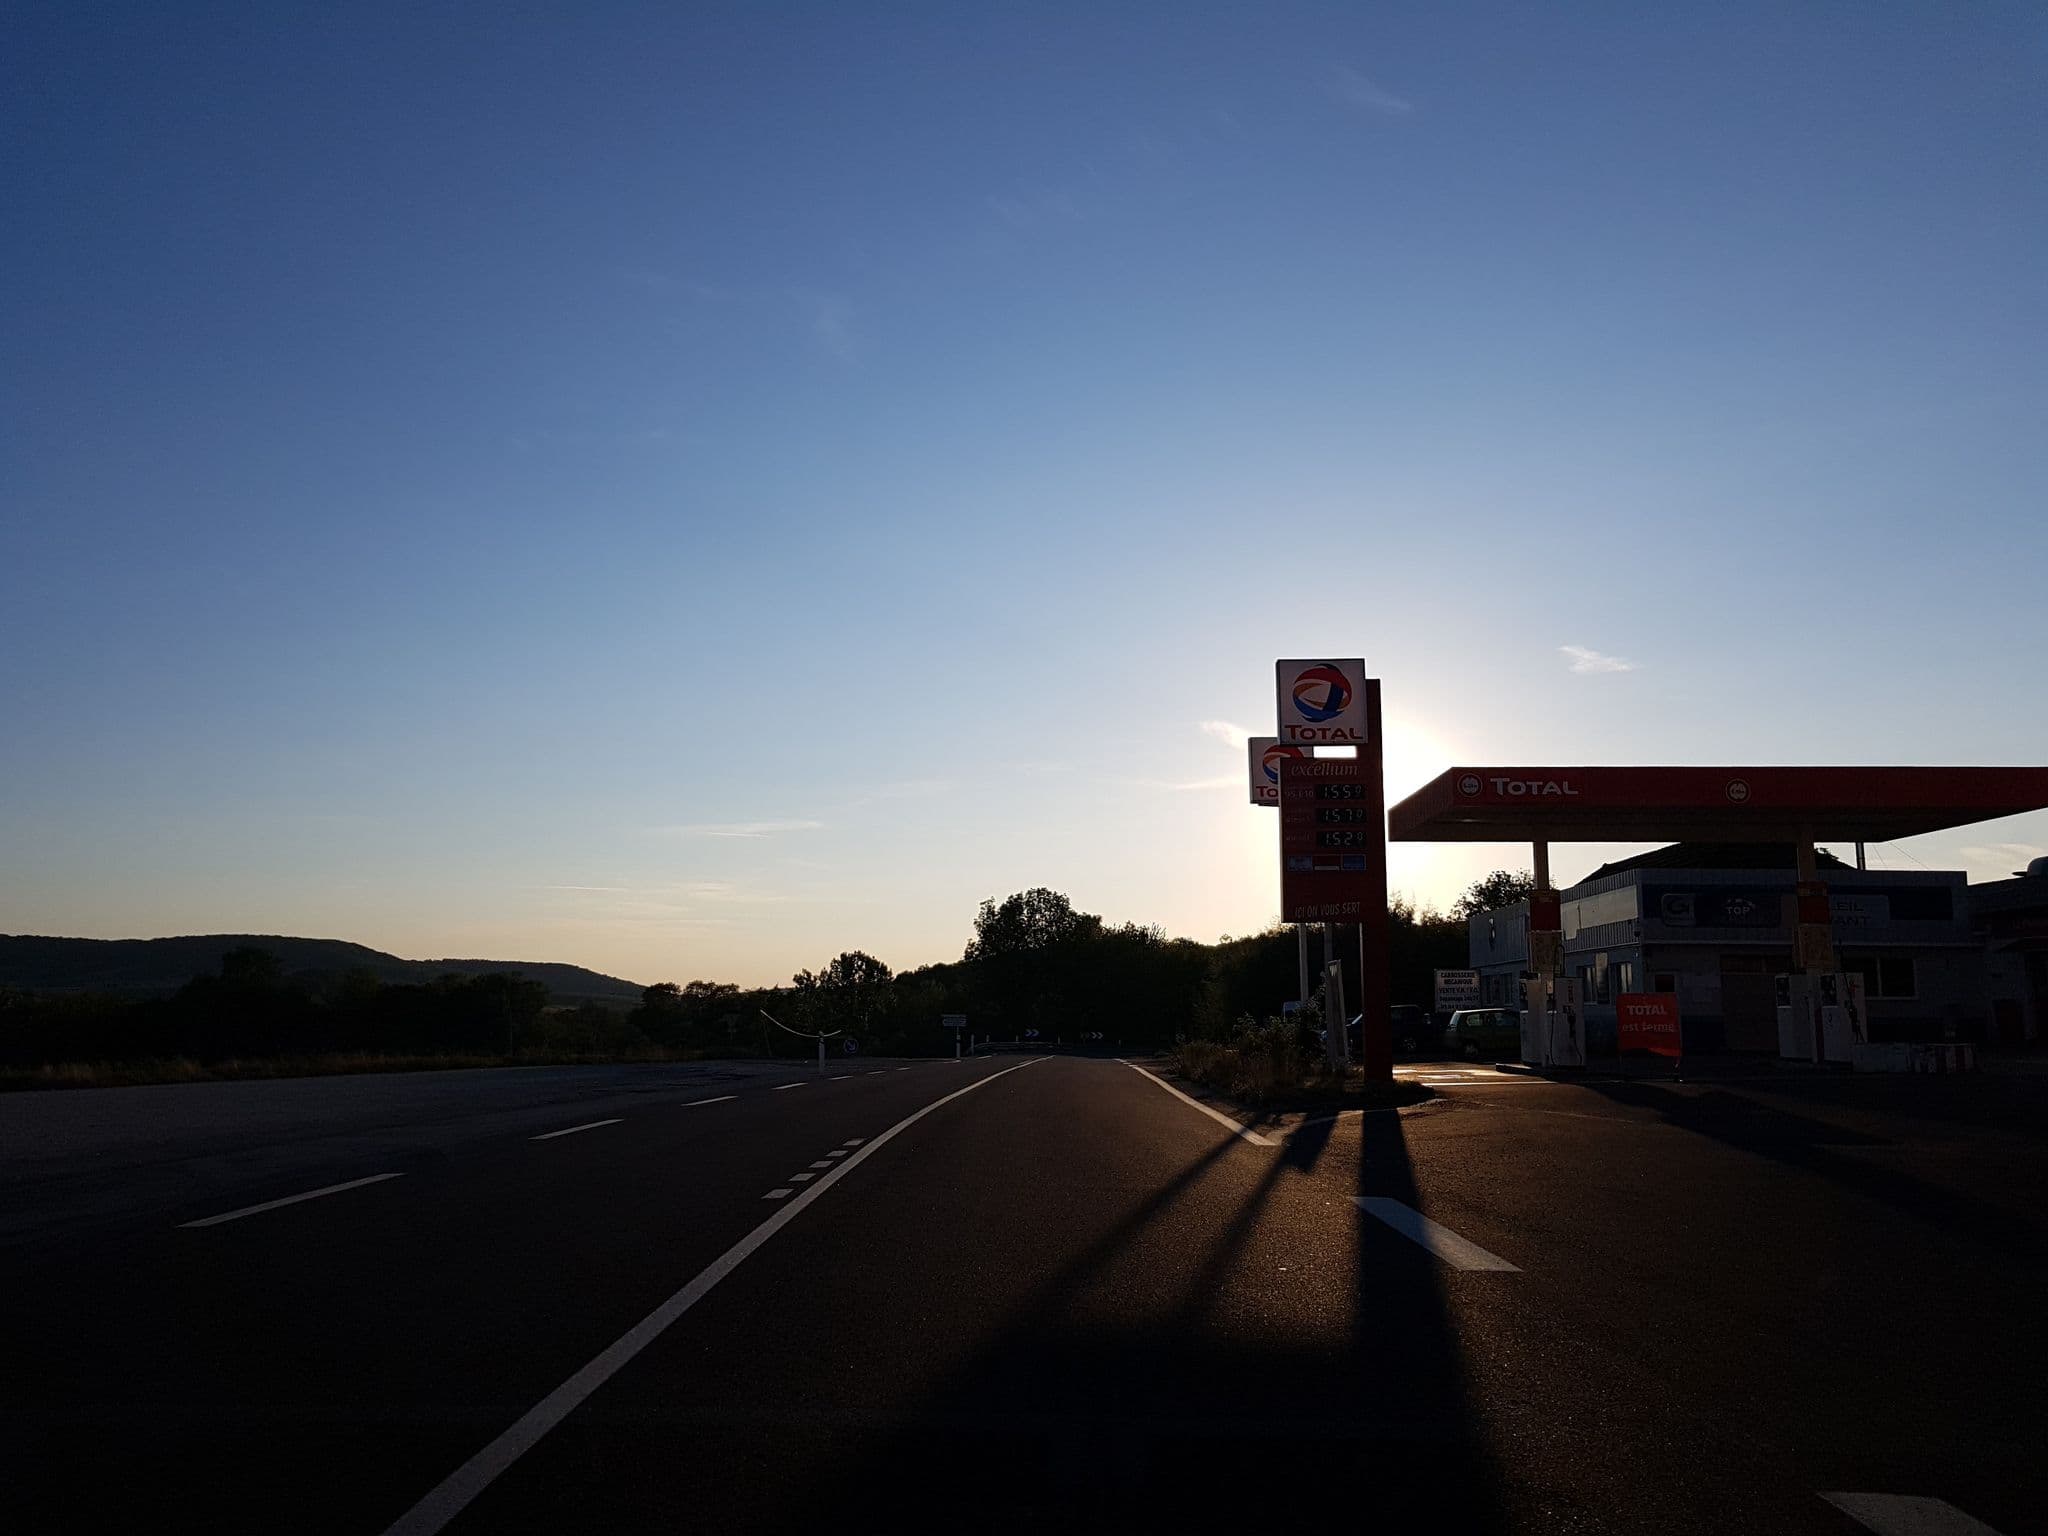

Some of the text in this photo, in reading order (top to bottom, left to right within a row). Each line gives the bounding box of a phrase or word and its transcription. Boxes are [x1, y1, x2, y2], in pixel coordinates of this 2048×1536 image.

[1285, 725, 1363, 741] TOTAL
[1291, 762, 1360, 777] excellium
[1255, 785, 1279, 798] TO
[1490, 778, 1578, 796] TOTAL
[1626, 1004, 1668, 1015] TOTAL
